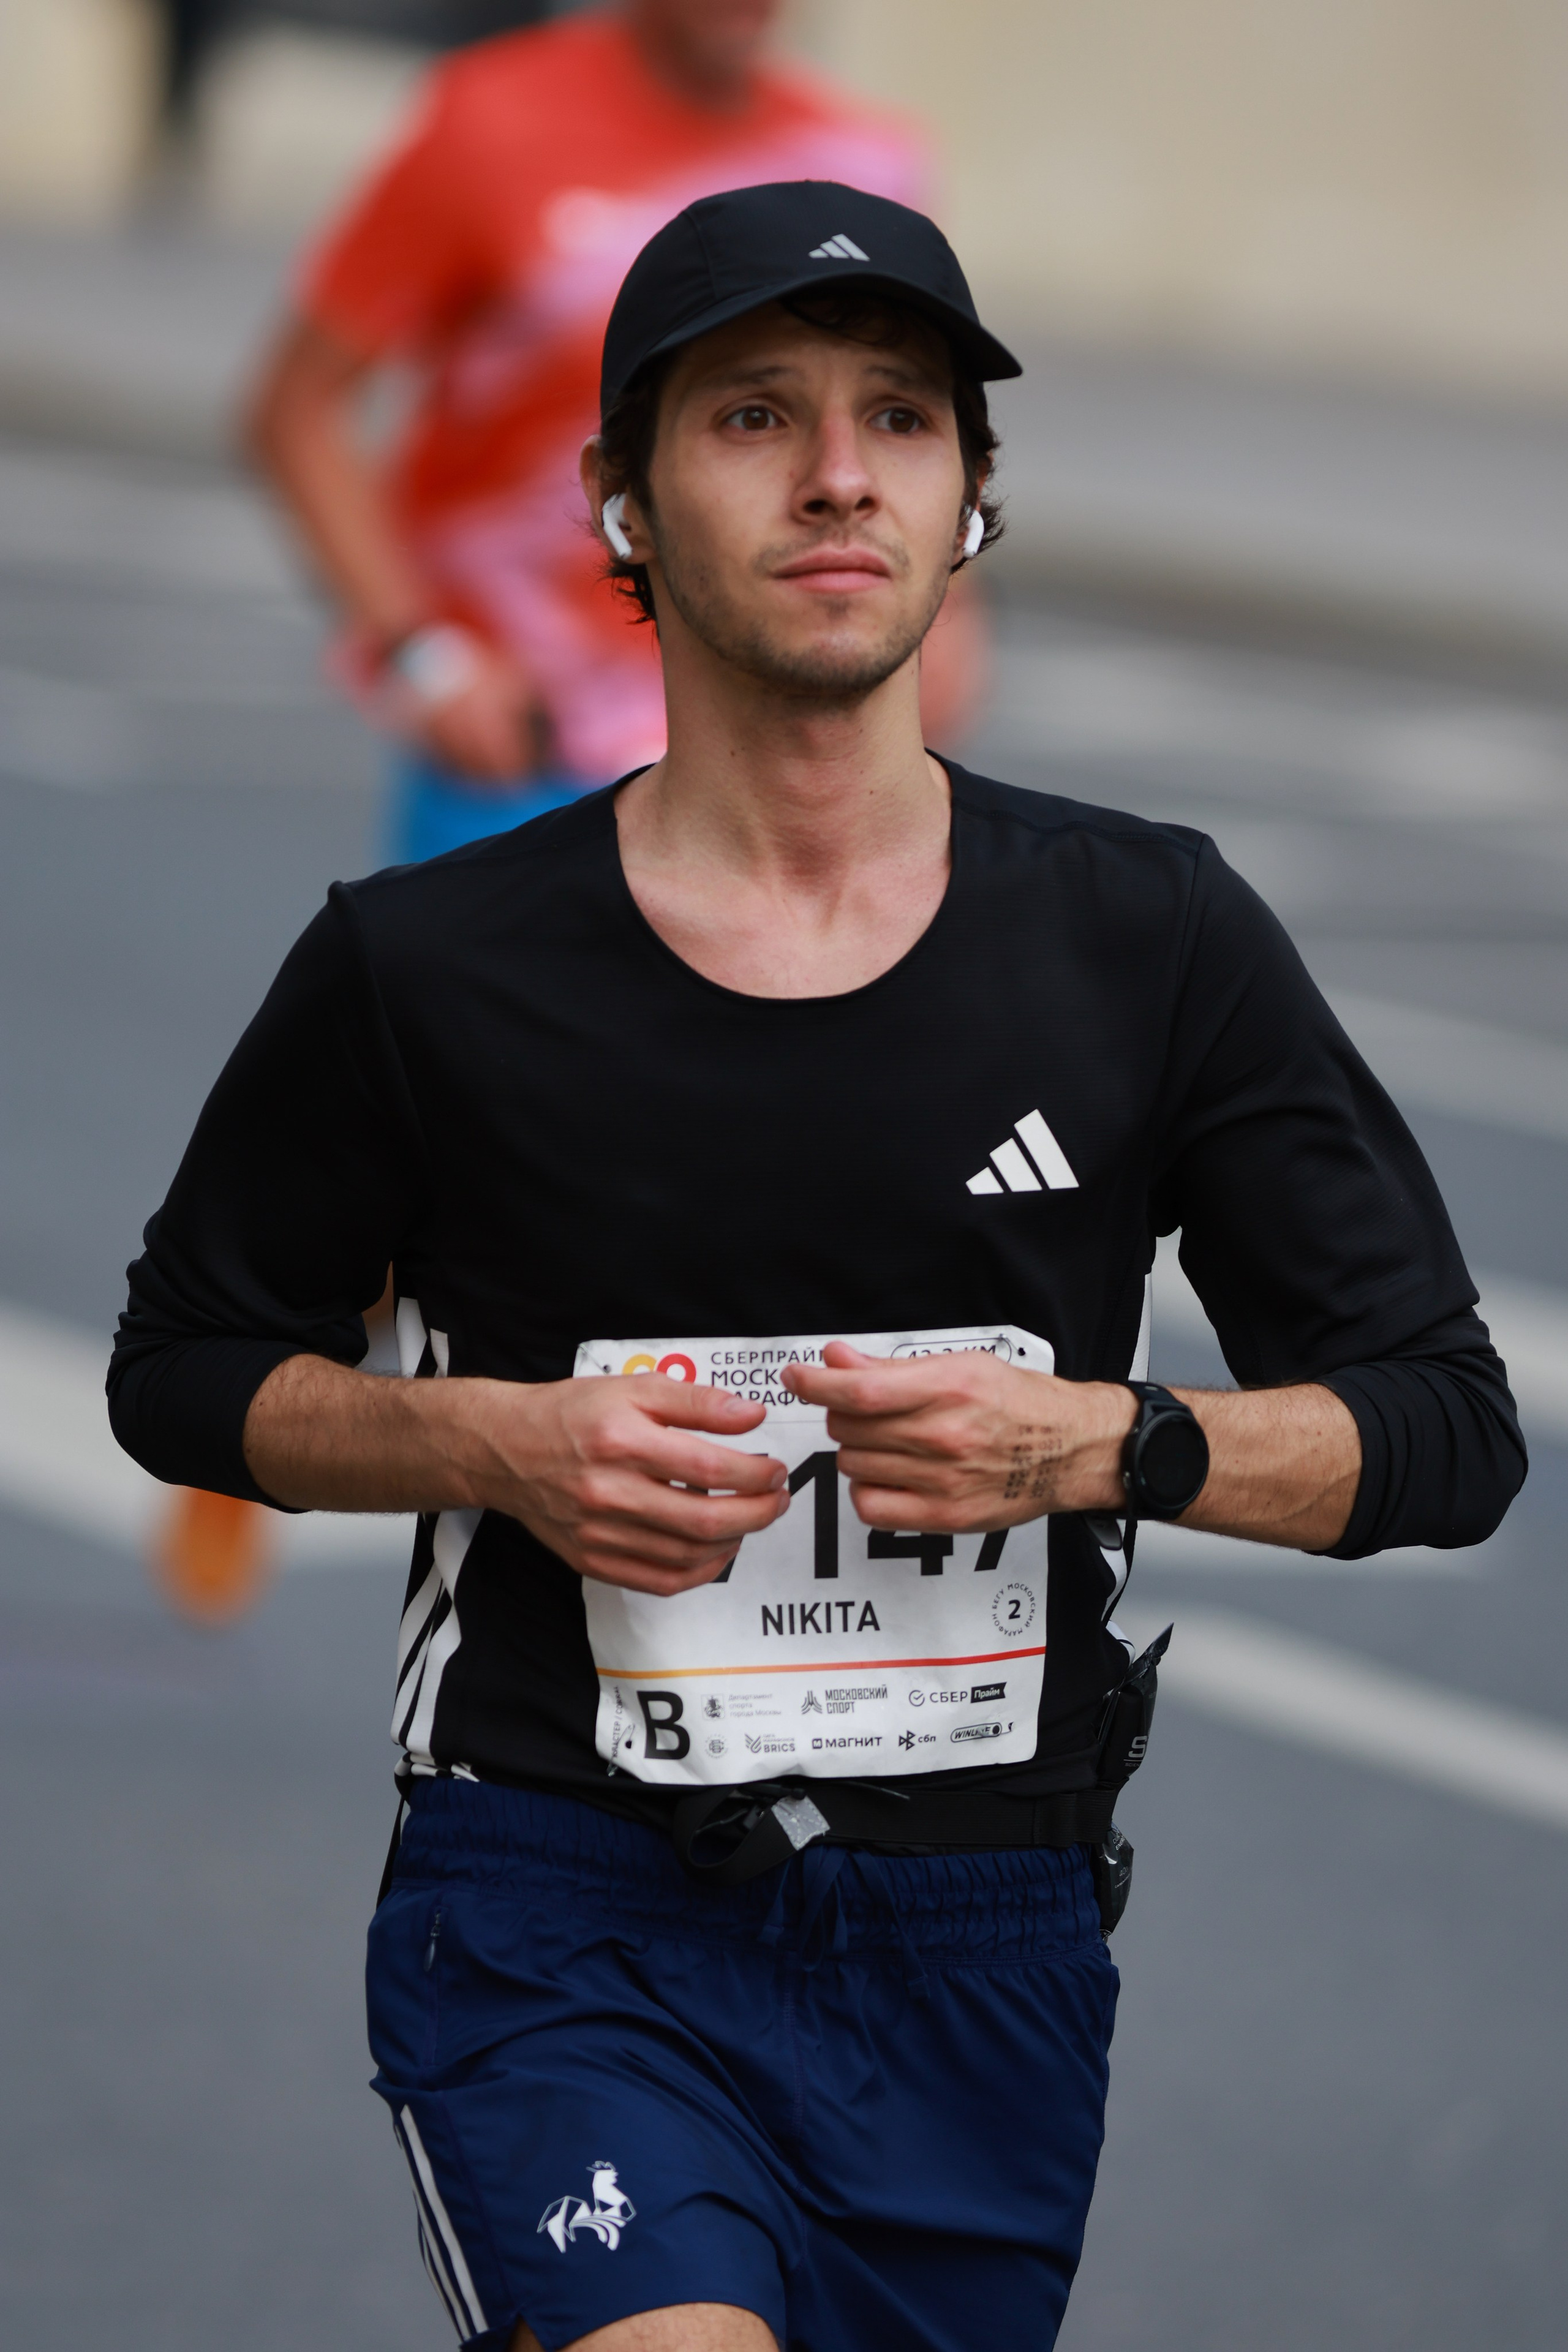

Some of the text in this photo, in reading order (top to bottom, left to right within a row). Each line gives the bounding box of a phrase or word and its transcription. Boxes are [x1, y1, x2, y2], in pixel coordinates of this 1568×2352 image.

[711, 1368, 778, 1386] МОСК
[1008, 1599, 1020, 1620] 2
[761, 1600, 881, 1636] NIKITA
[825, 1684, 888, 1701] МОСКОВСКИЙ
[929, 1687, 1001, 1703] СБЕР Прайм
[826, 1701, 855, 1714] СПОРТ
[636, 1691, 690, 1760] B
[825, 1736, 883, 1748] магнит
[918, 1734, 937, 1743] сбп
[763, 1743, 796, 1753] BRICS
